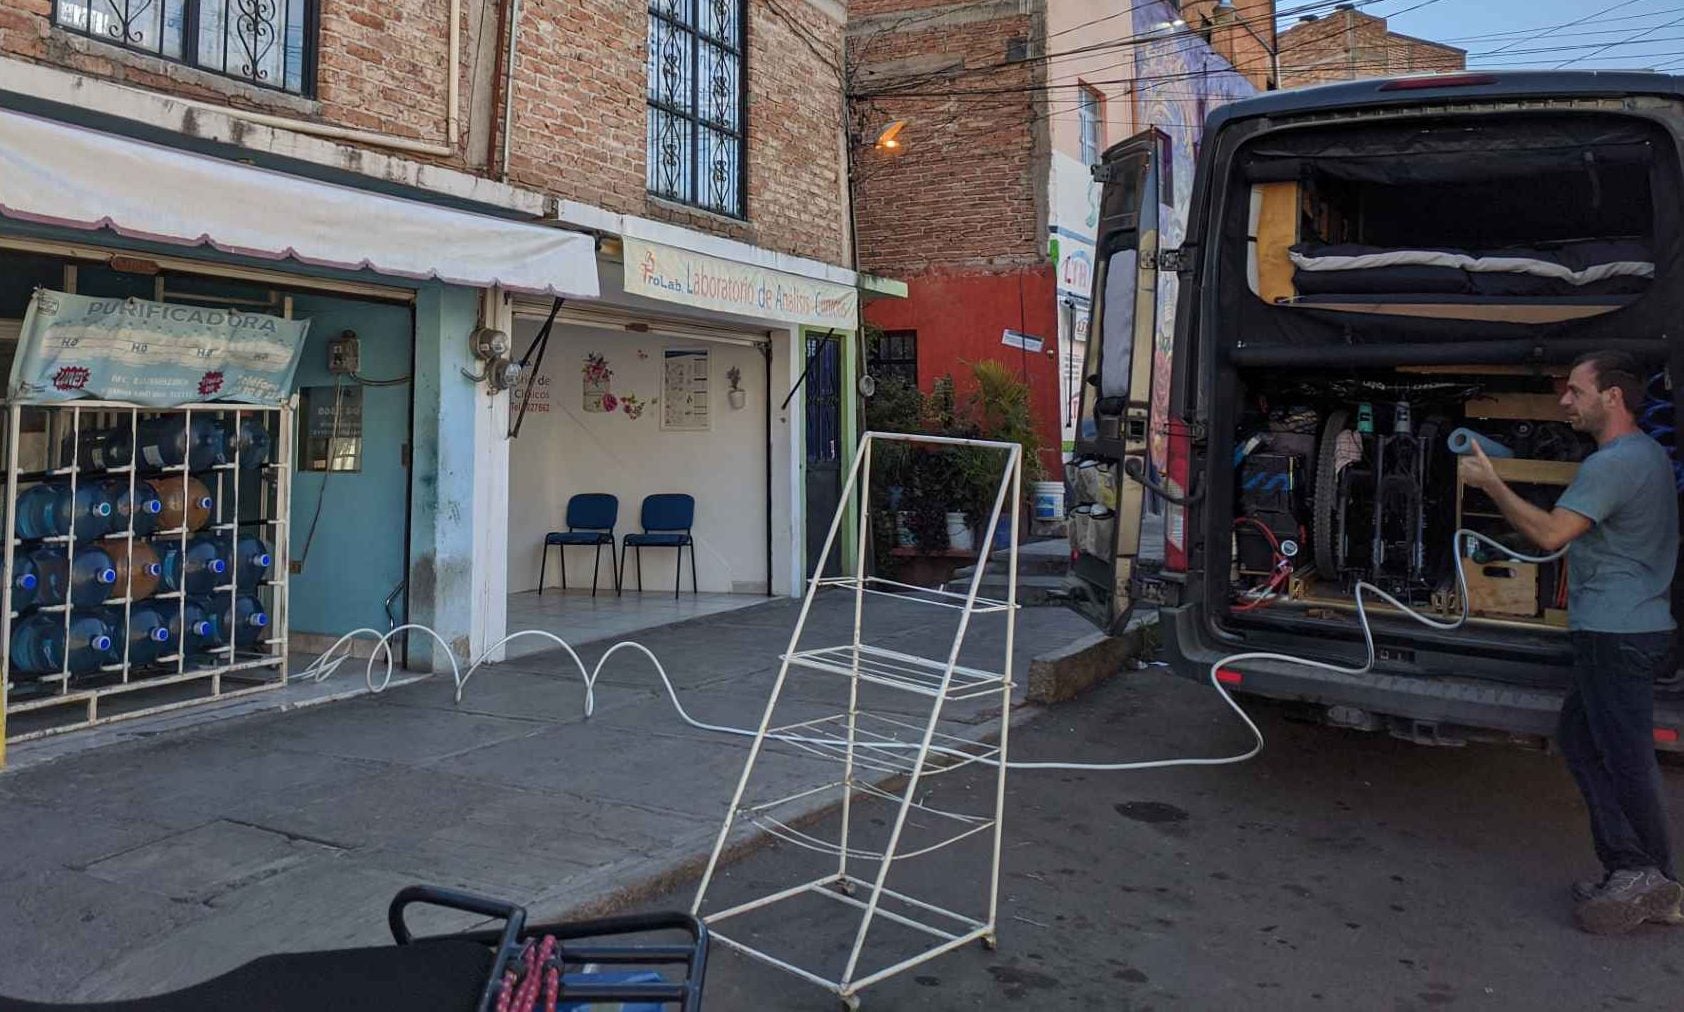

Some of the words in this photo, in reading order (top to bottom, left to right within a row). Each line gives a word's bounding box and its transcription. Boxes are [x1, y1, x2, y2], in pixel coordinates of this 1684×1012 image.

[687, 260, 754, 304] Laboratorio
[758, 276, 772, 310] de
[87, 301, 277, 333] PURIFICADORA
[514, 388, 549, 399] Clicos
